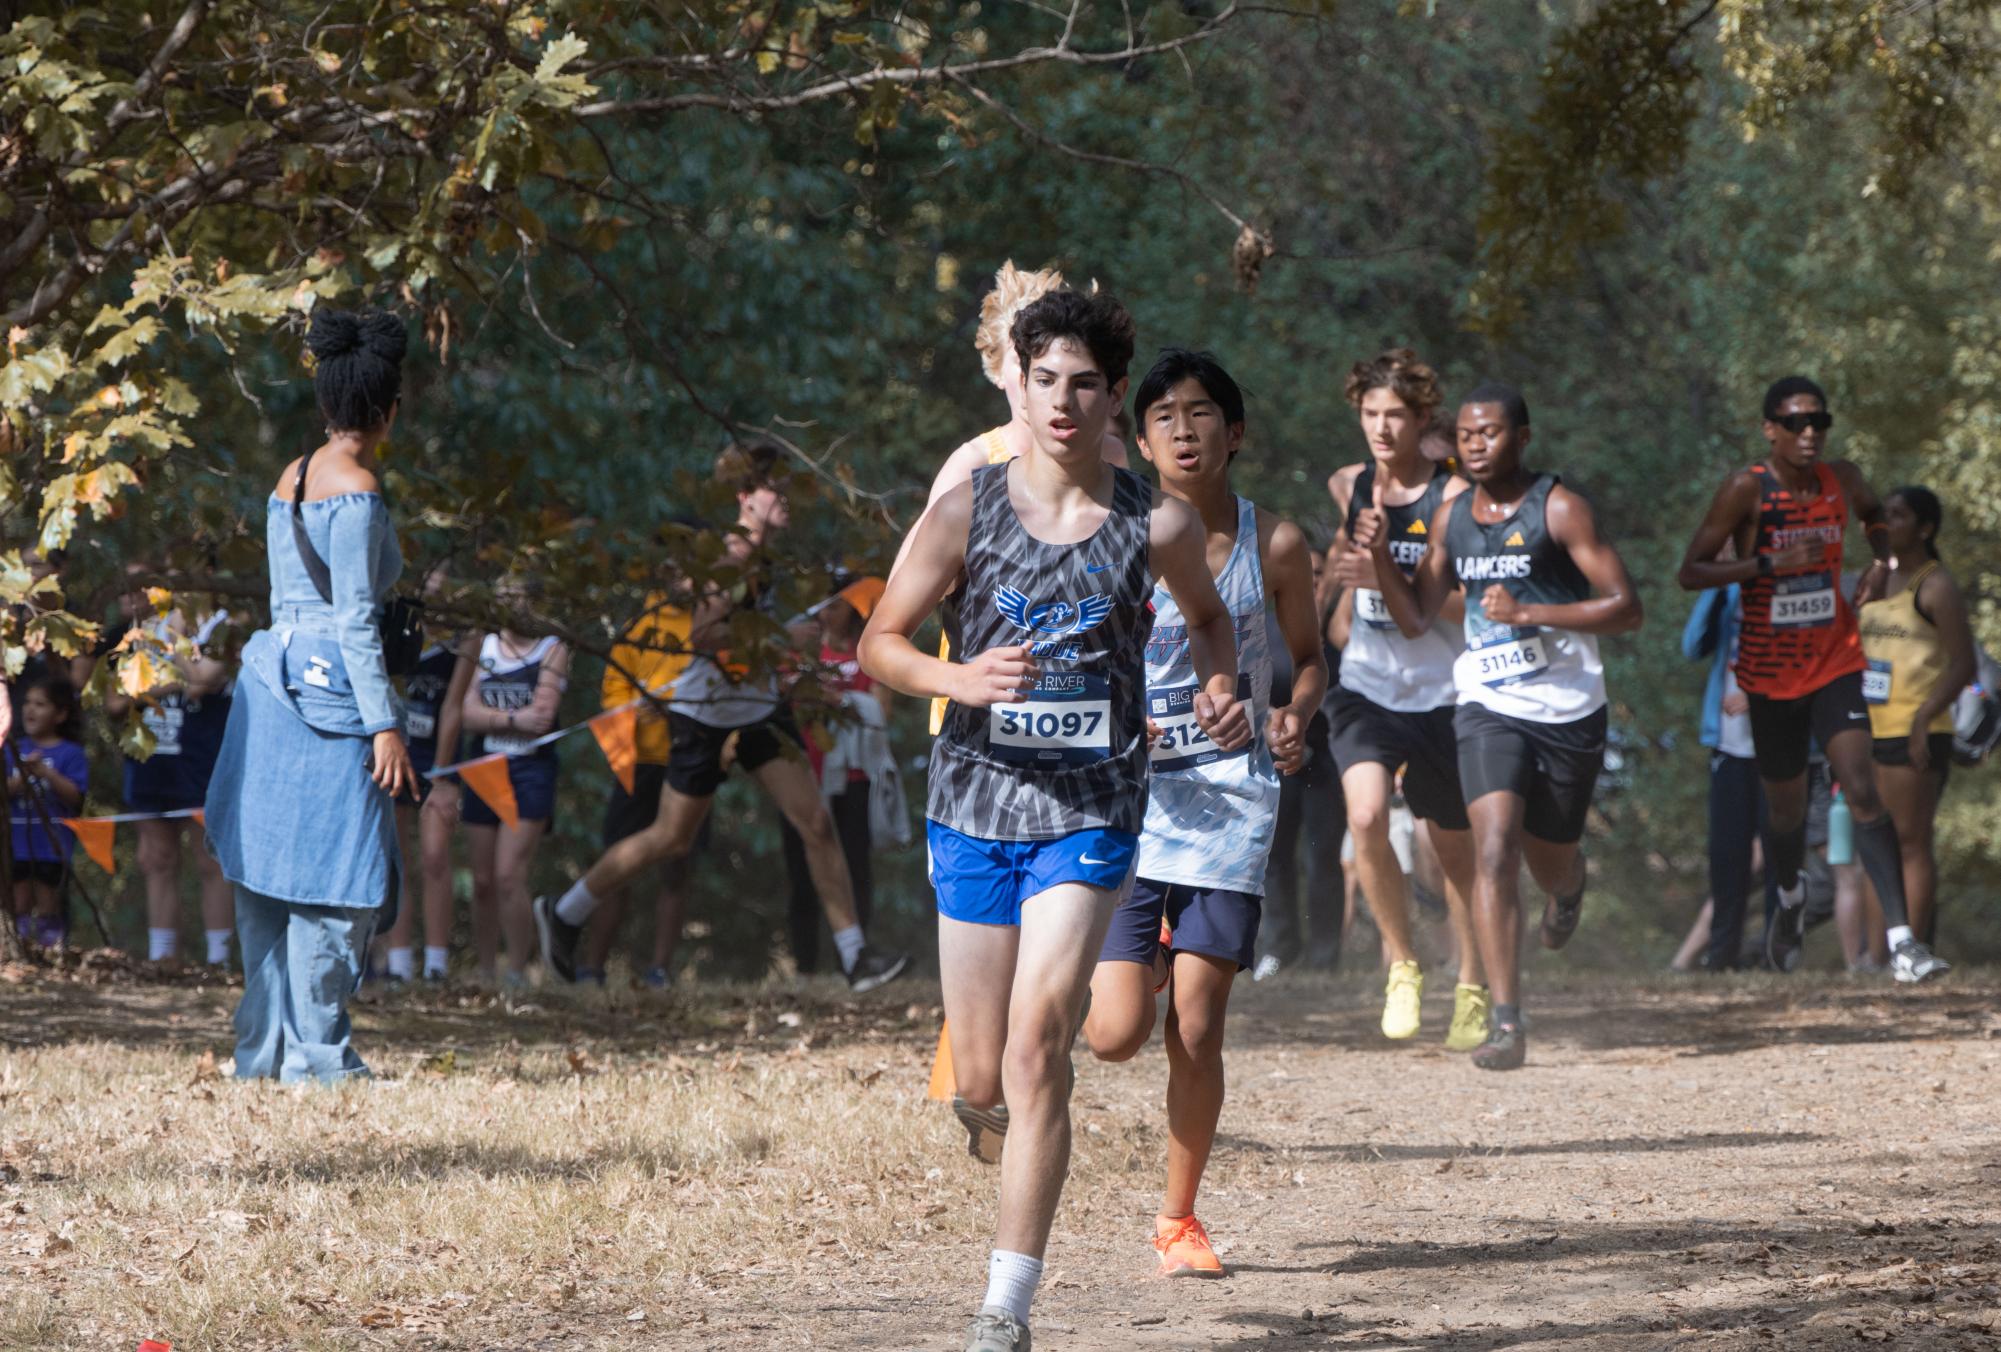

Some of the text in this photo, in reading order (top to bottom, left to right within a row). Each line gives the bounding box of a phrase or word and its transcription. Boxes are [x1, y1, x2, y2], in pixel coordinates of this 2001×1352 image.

[1456, 555, 1532, 580] LANCERS
[1777, 596, 1831, 617] 31459
[1480, 647, 1536, 673] 31146
[1045, 675, 1085, 687] RIVER
[1168, 690, 1190, 703] BIG
[1000, 711, 1103, 737] 31097
[1158, 723, 1209, 750] 312
